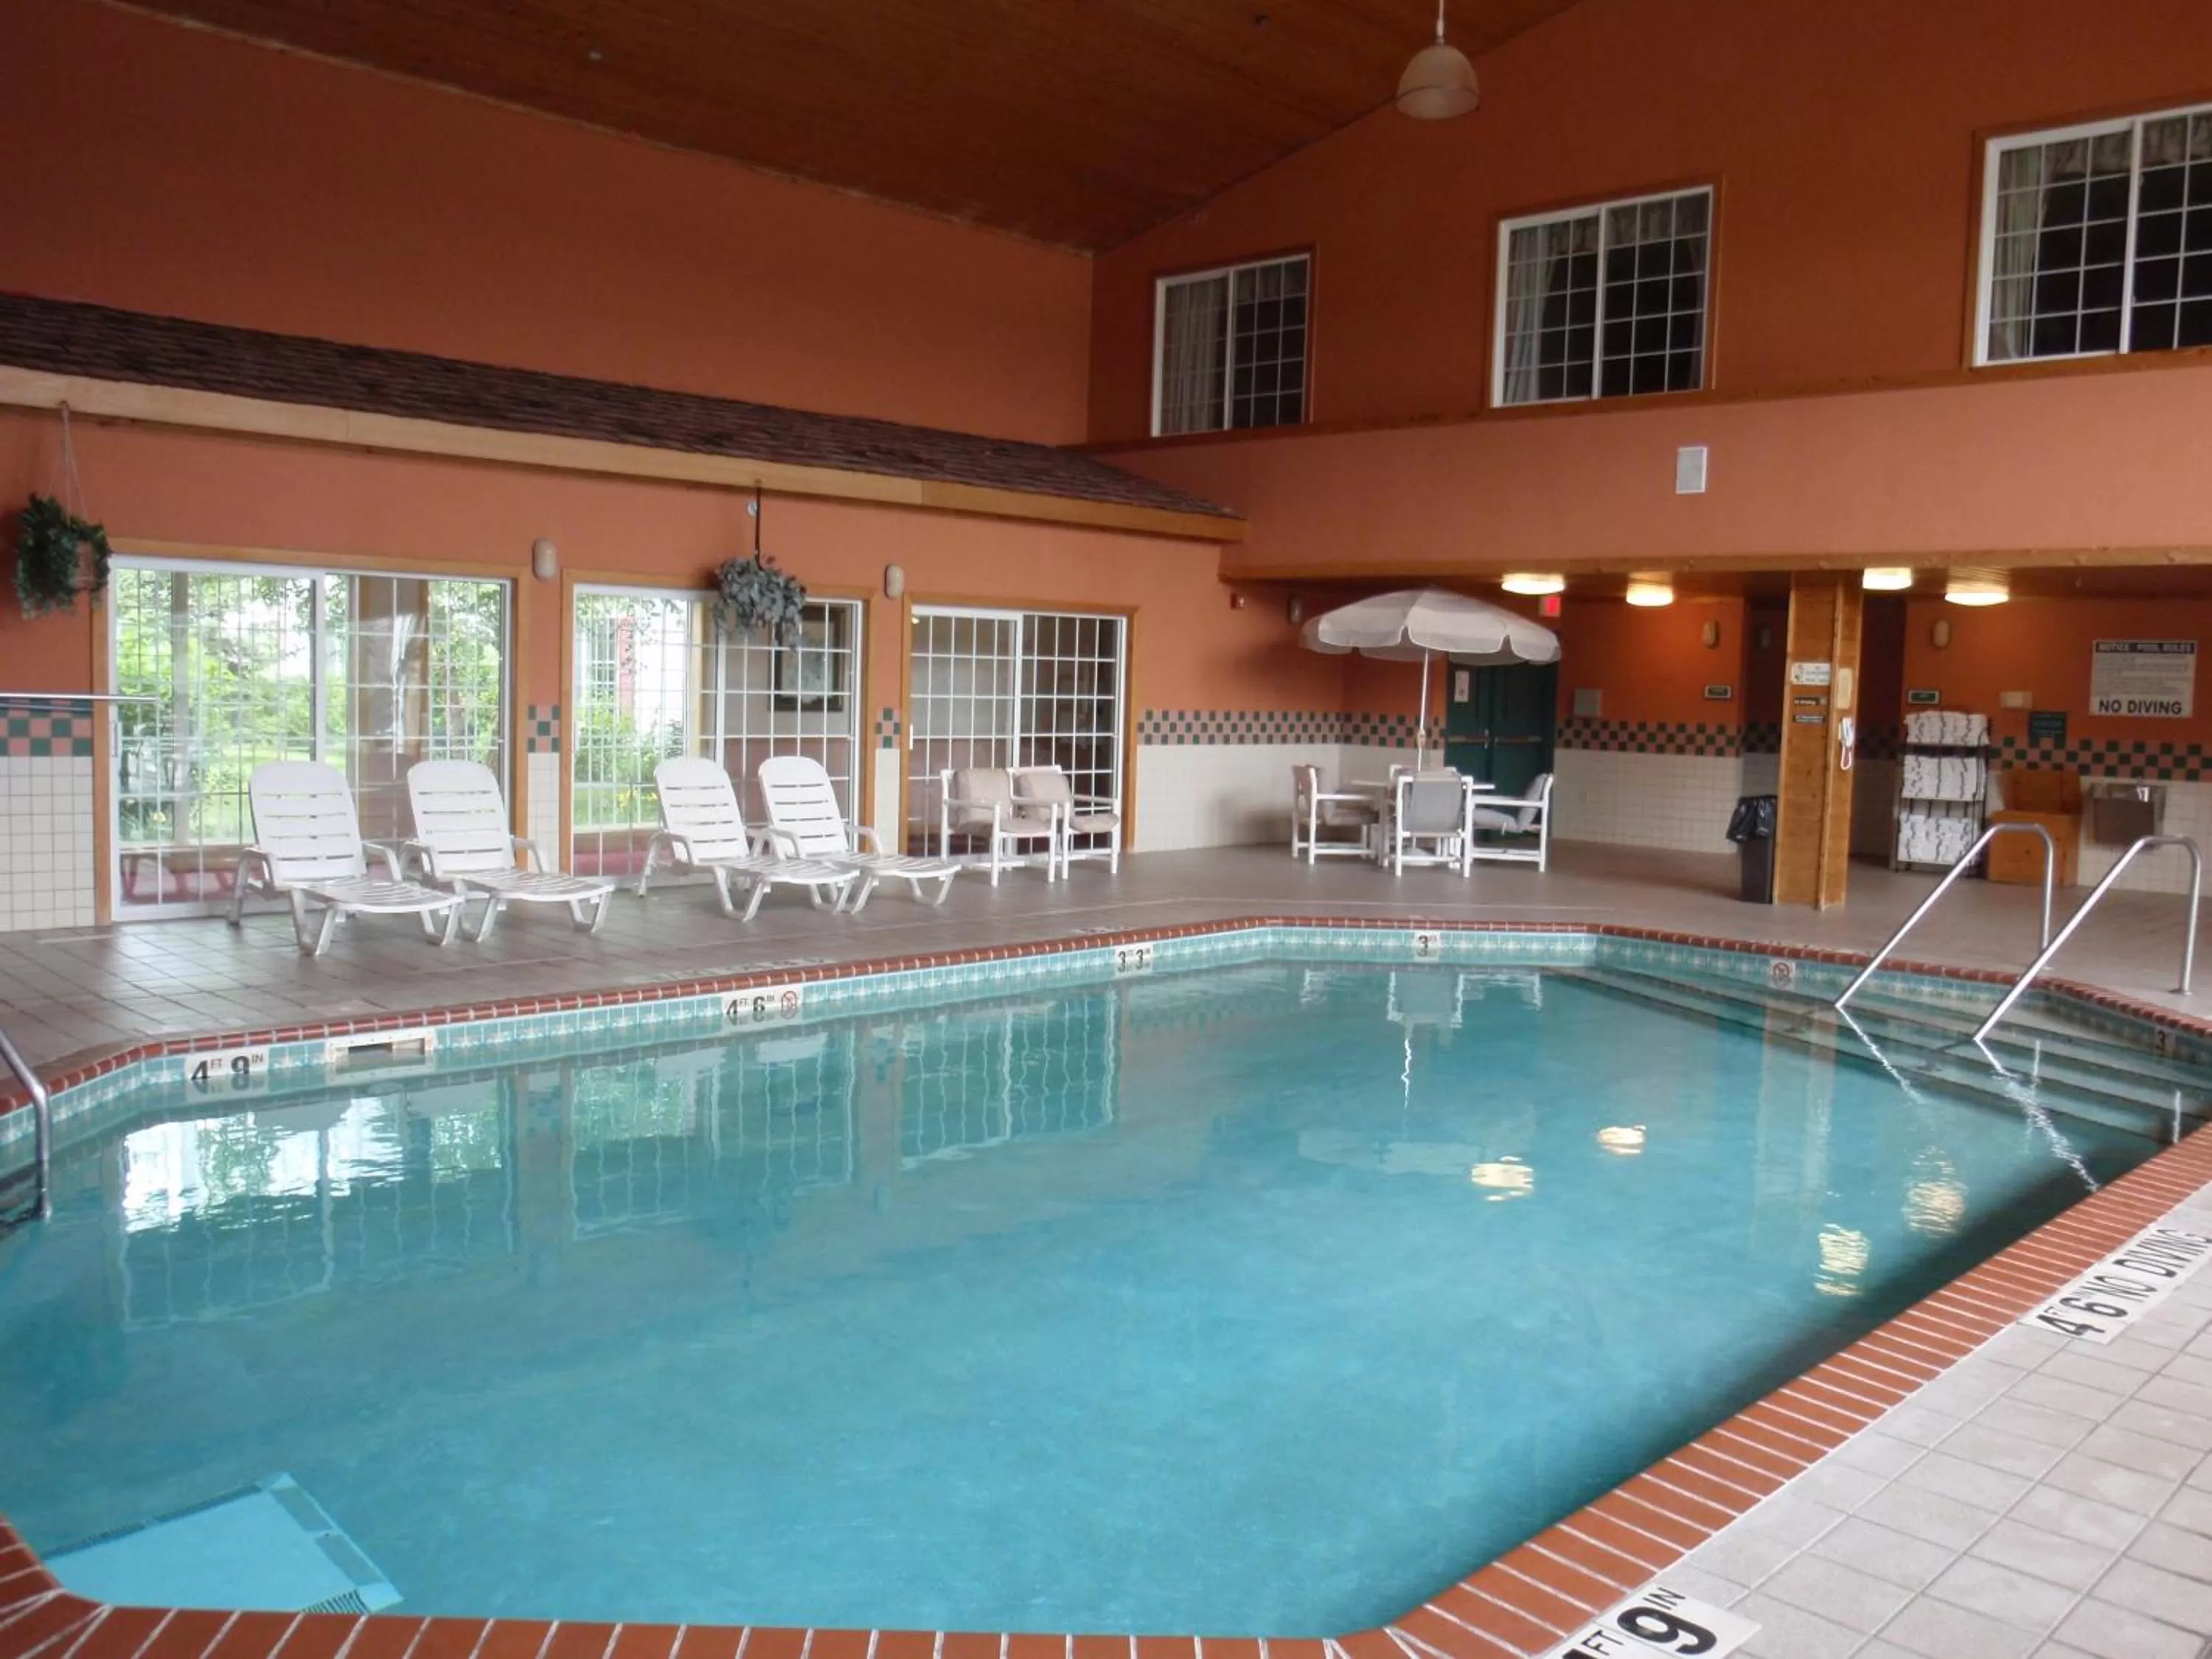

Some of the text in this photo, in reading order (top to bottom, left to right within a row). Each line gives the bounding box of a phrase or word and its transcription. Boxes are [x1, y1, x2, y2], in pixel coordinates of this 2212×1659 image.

[2098, 700, 2183, 714] NO DIVING
[2079, 1275, 2158, 1303] NO
[2059, 1297, 2129, 1318] 6
[2035, 1314, 2106, 1336] 4
[1643, 1587, 1686, 1610] IN
[1617, 1607, 1717, 1655] 9
[1580, 1630, 1624, 1656] FT
